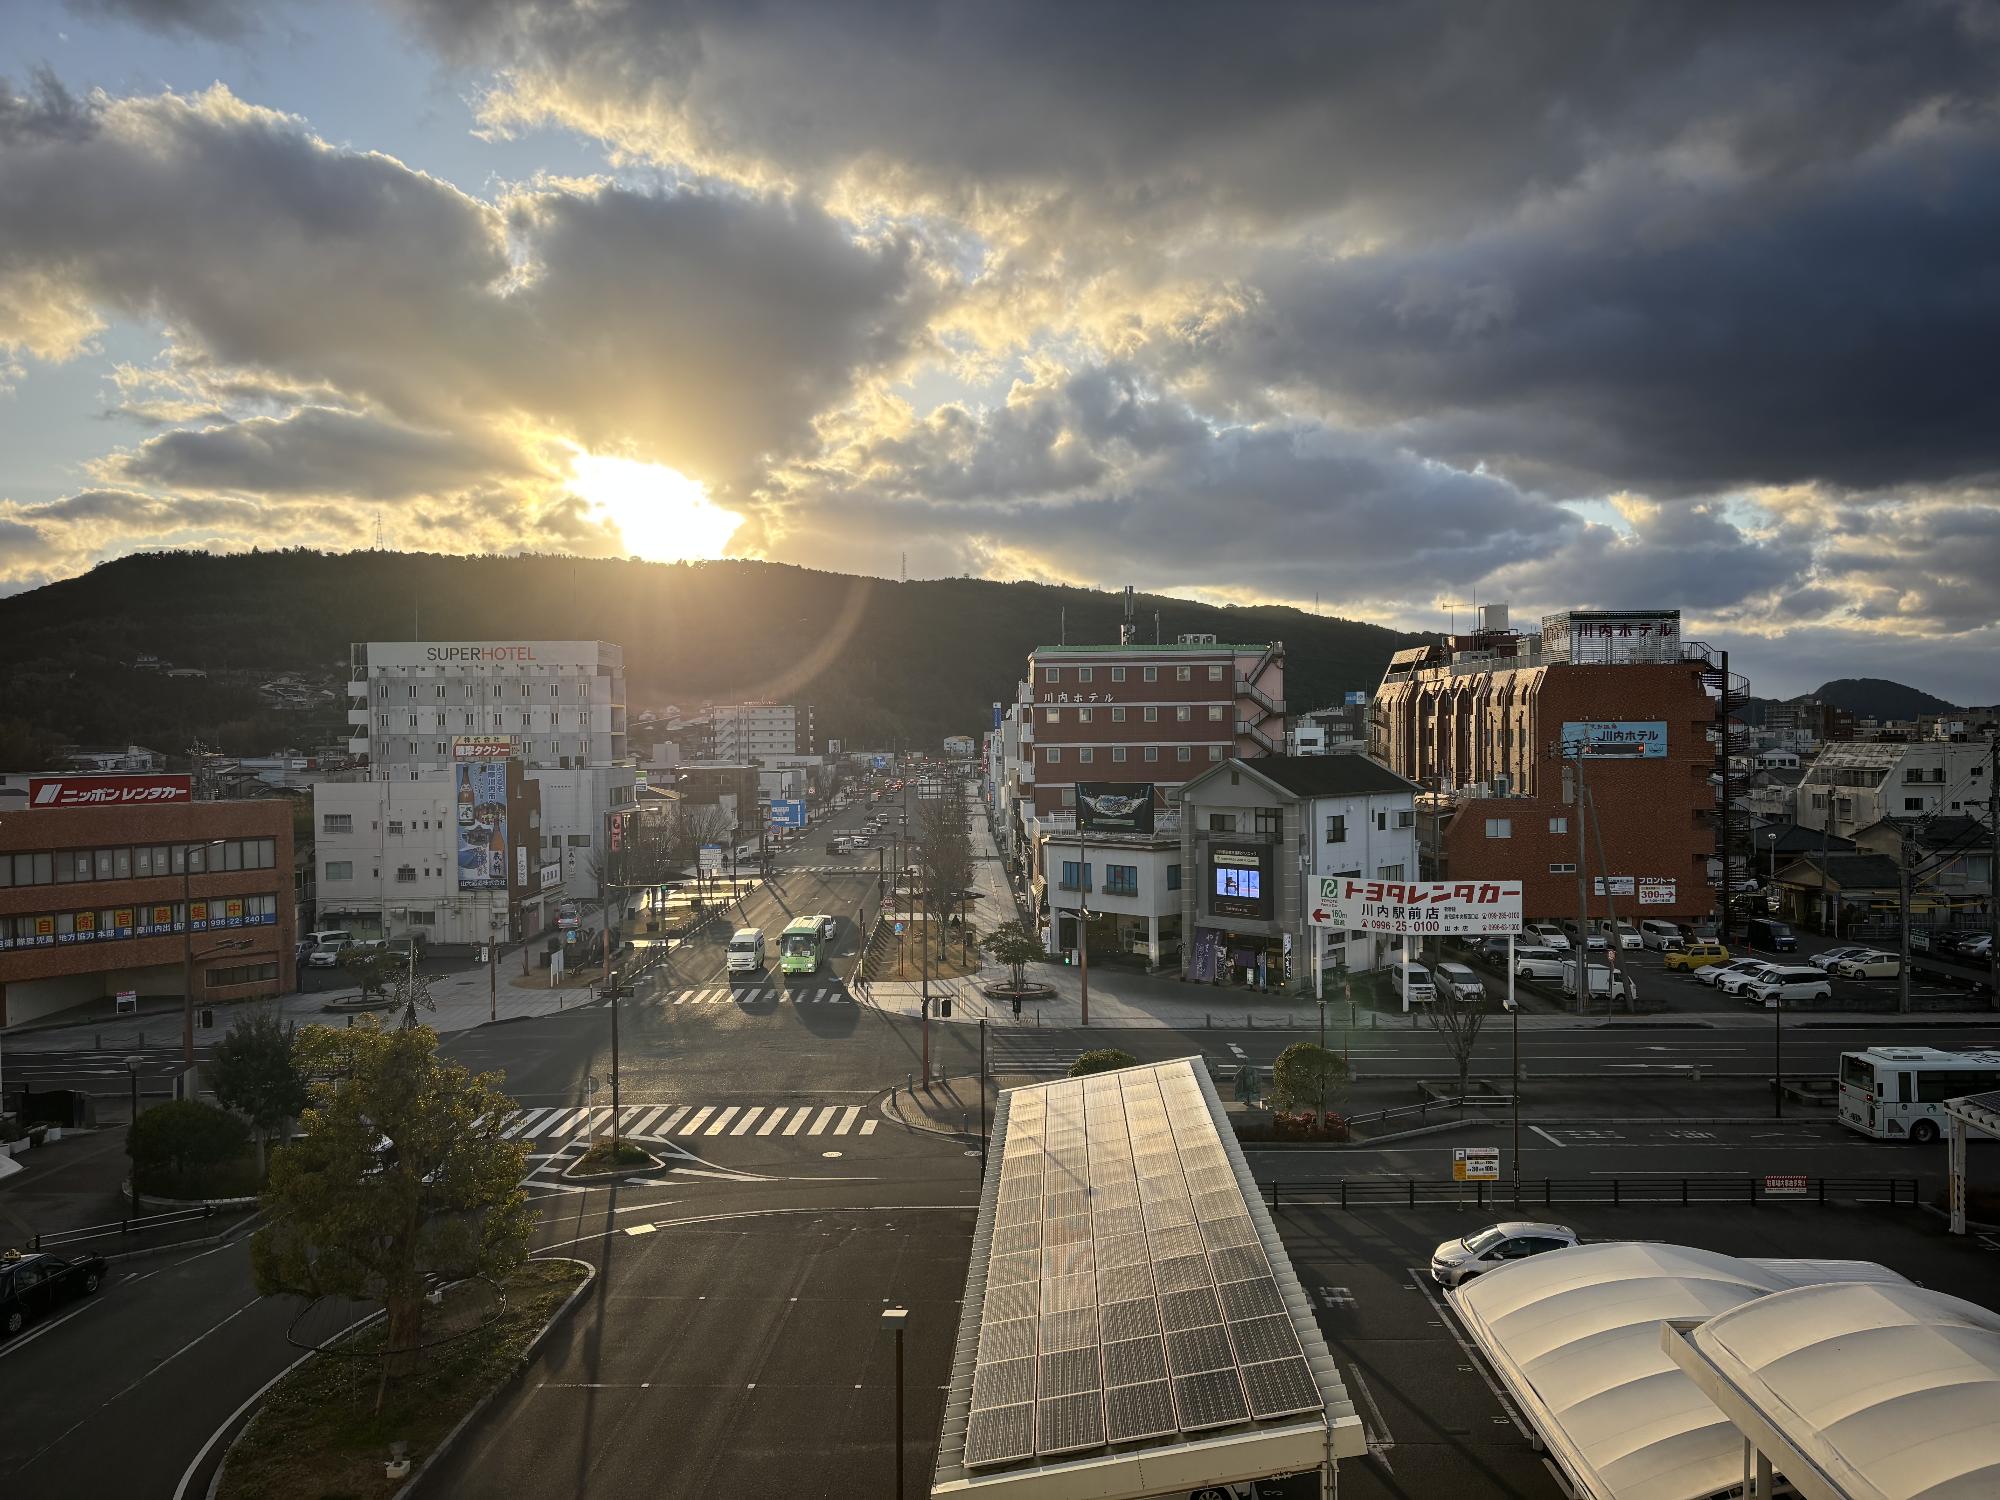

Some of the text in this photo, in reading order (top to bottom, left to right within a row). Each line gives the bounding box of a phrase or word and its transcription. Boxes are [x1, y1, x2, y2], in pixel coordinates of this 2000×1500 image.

[1579, 623, 1671, 638] 川内ホテル
[427, 646, 537, 661] SUPERHOTEL
[1043, 691, 1114, 704] 川内ホテル
[1602, 730, 1658, 741] 川内ホテル
[455, 745, 510, 756] 薩摩タクシー
[1639, 877, 1667, 885] フロント
[1345, 881, 1521, 904] トヨタレンタカー
[1361, 903, 1440, 920] 川内駅前店
[1371, 920, 1440, 932] 0996-25-0100
